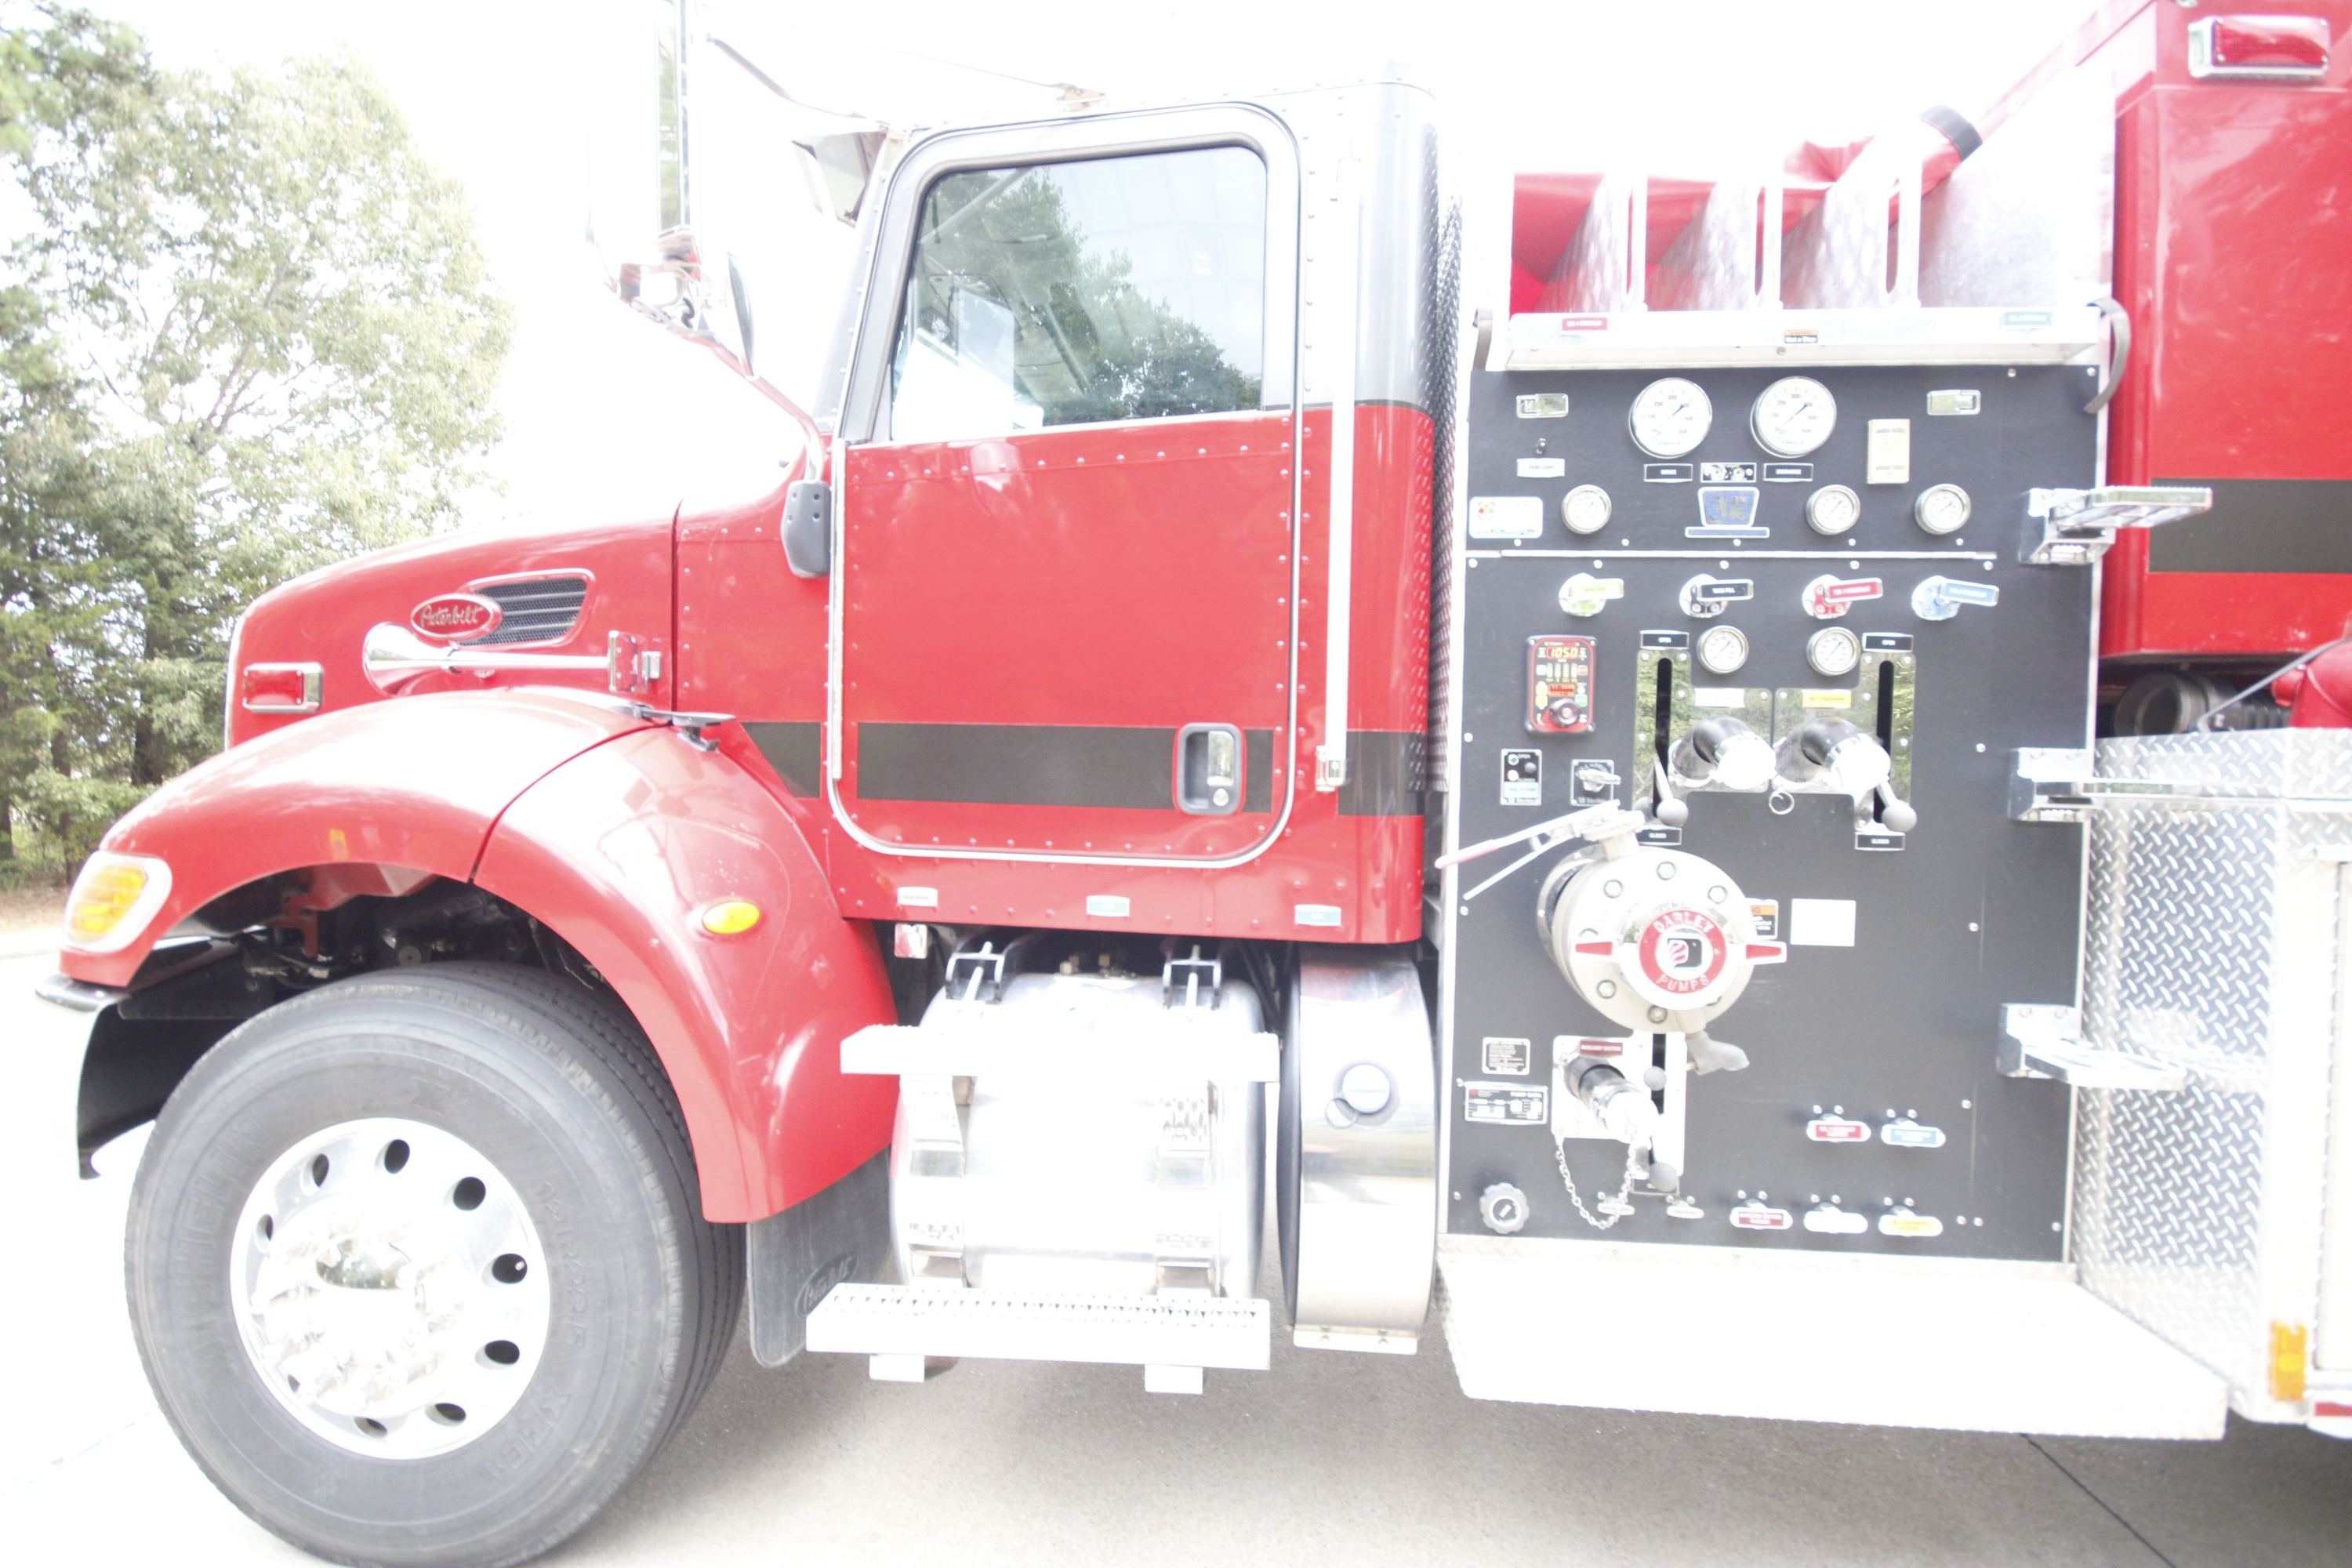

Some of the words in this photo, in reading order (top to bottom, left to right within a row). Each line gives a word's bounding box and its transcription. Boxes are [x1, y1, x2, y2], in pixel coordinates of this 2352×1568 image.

[419, 604, 485, 628] Peterbilt
[1551, 647, 1578, 658] 1050
[1653, 911, 1715, 934] DARLEY
[1657, 973, 1710, 993] PUMPS
[535, 1180, 588, 1349] 12R22.5
